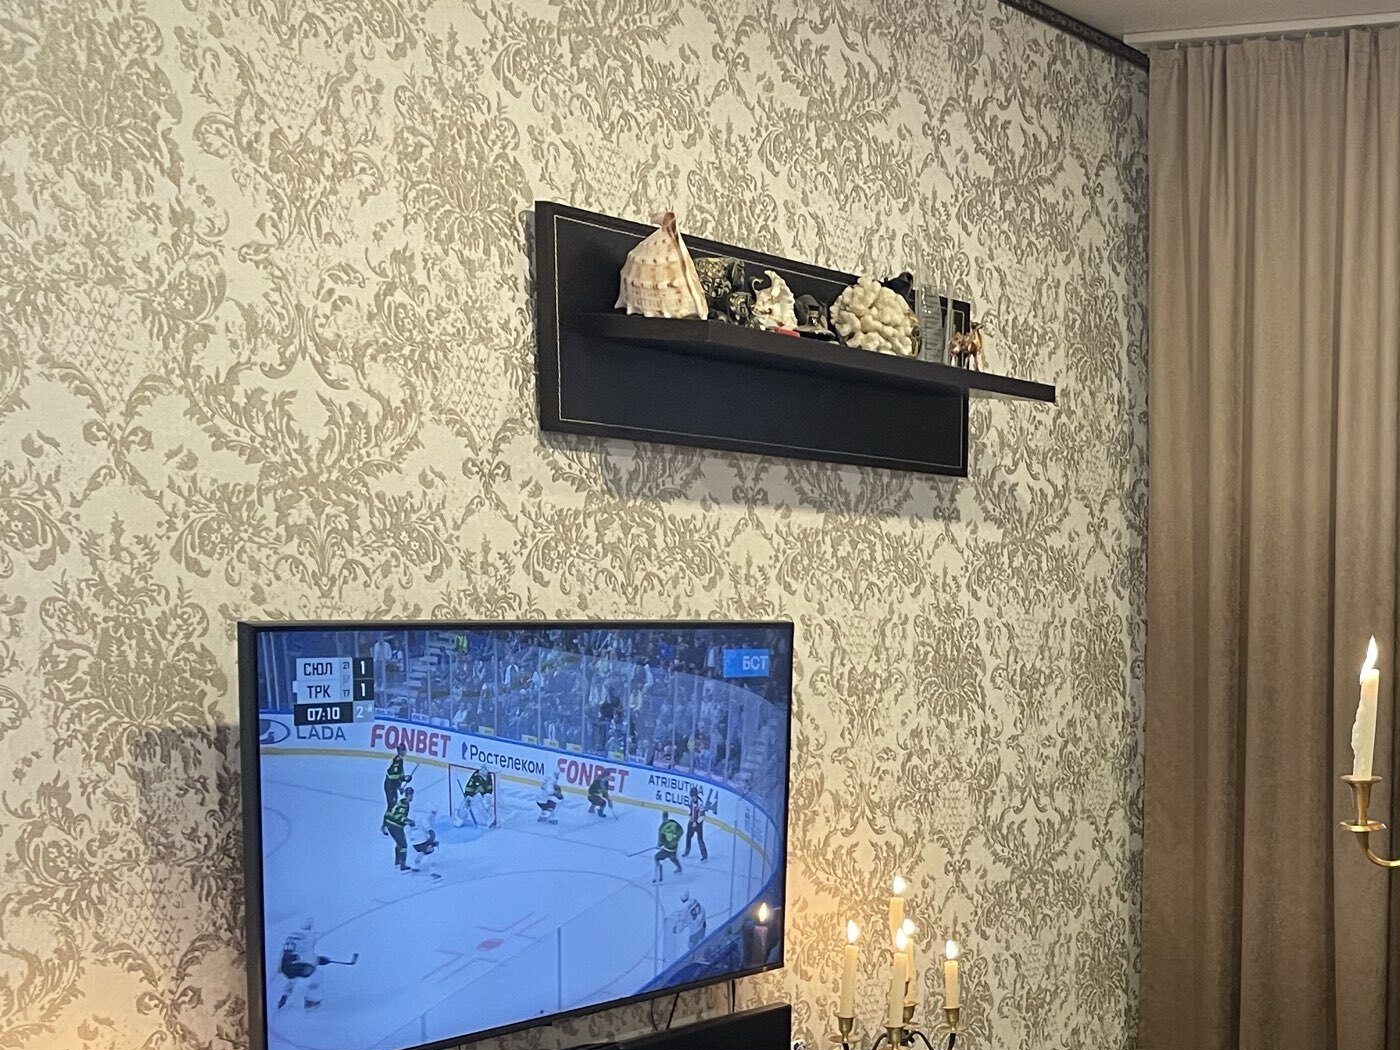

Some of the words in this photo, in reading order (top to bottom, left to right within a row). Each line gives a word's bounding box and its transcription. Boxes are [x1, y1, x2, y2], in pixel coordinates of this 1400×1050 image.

[303, 662, 333, 676] СЮЛ
[360, 661, 366, 675] 1
[743, 655, 769, 671] БСТ
[306, 685, 331, 699] ТРК
[360, 683, 366, 697] 1
[307, 707, 340, 721] 07:10
[296, 726, 347, 741] LADA
[370, 724, 451, 758] FONBET
[469, 744, 545, 776] Ростелеком
[655, 789, 663, 800] &
